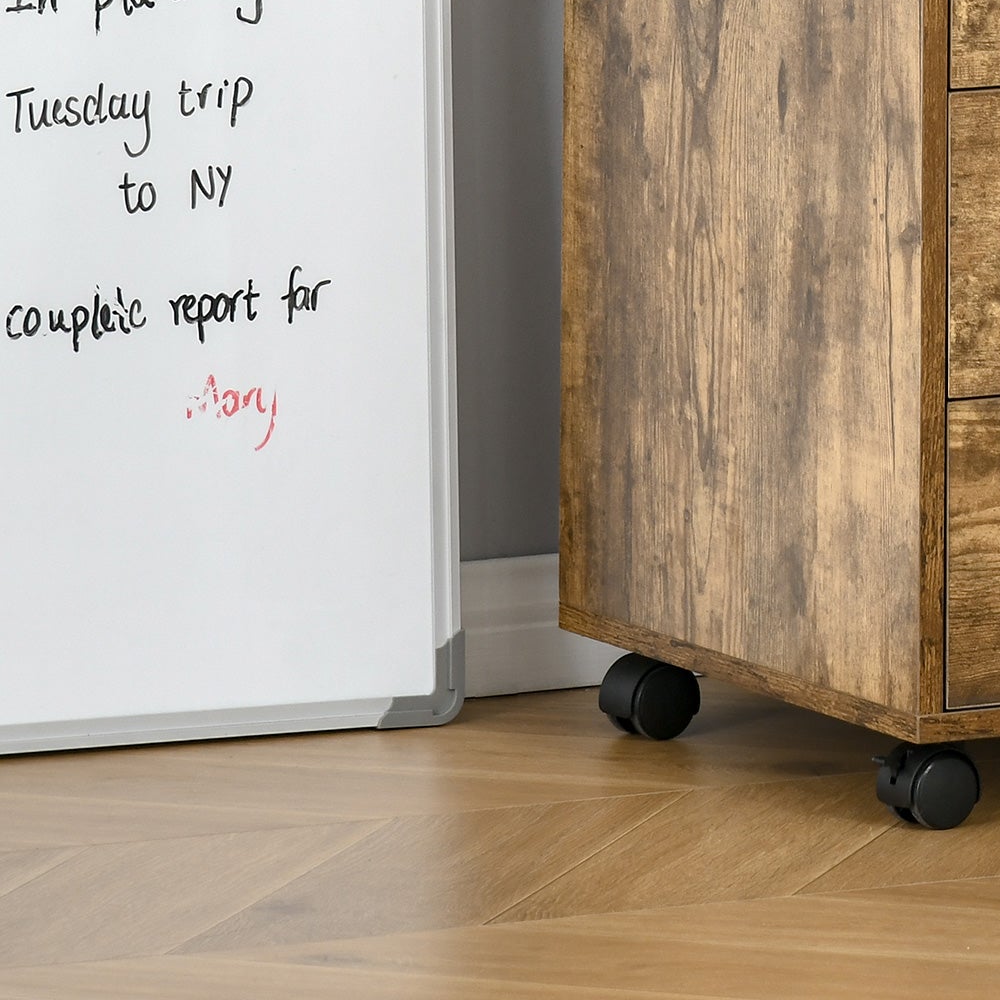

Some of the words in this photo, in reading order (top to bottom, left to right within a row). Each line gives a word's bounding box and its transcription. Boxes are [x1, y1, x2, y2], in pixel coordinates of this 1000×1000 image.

[6, 83, 151, 158] Tuesday
[178, 76, 253, 127] trip
[118, 172, 157, 214] to
[190, 165, 232, 210] NY
[168, 278, 260, 344] report
